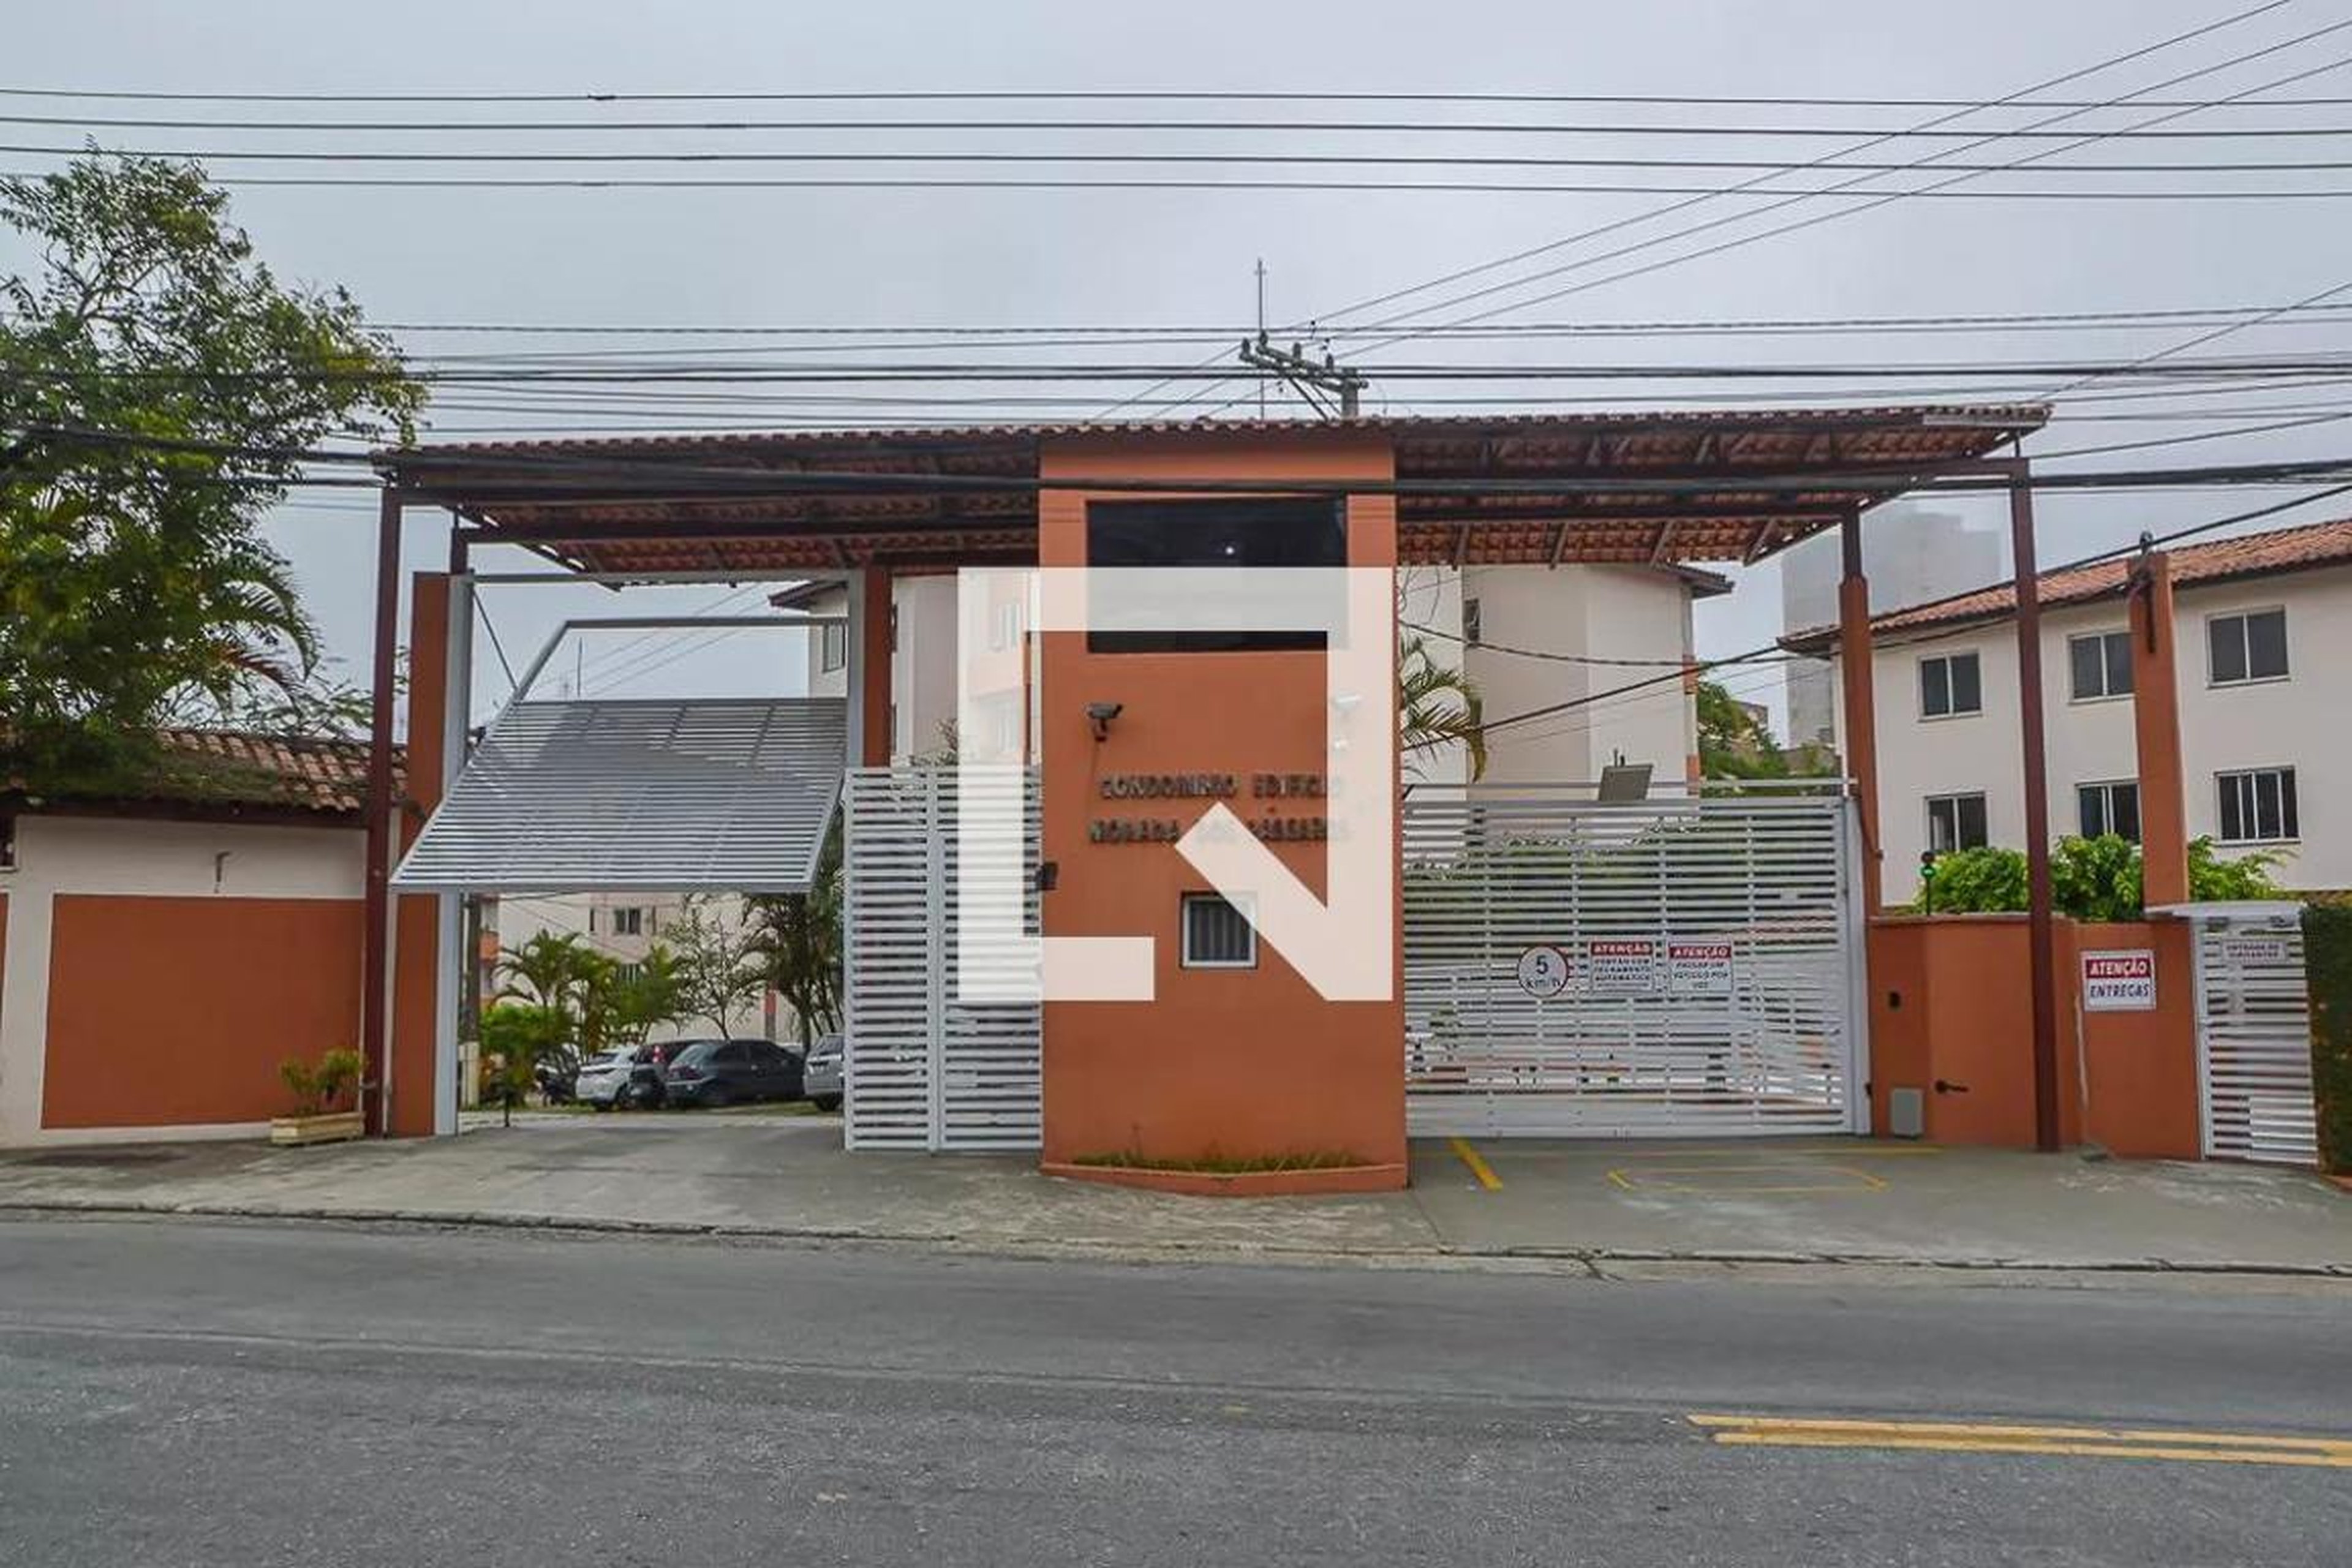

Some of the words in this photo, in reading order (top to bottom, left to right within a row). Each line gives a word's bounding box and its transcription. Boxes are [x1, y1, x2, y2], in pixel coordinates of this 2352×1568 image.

[1594, 943, 1650, 954] ATENÇÃO
[1675, 945, 1728, 958] ATENÇÃO
[1536, 955, 1548, 974] 5
[2089, 957, 2147, 975] ATENÇÃO
